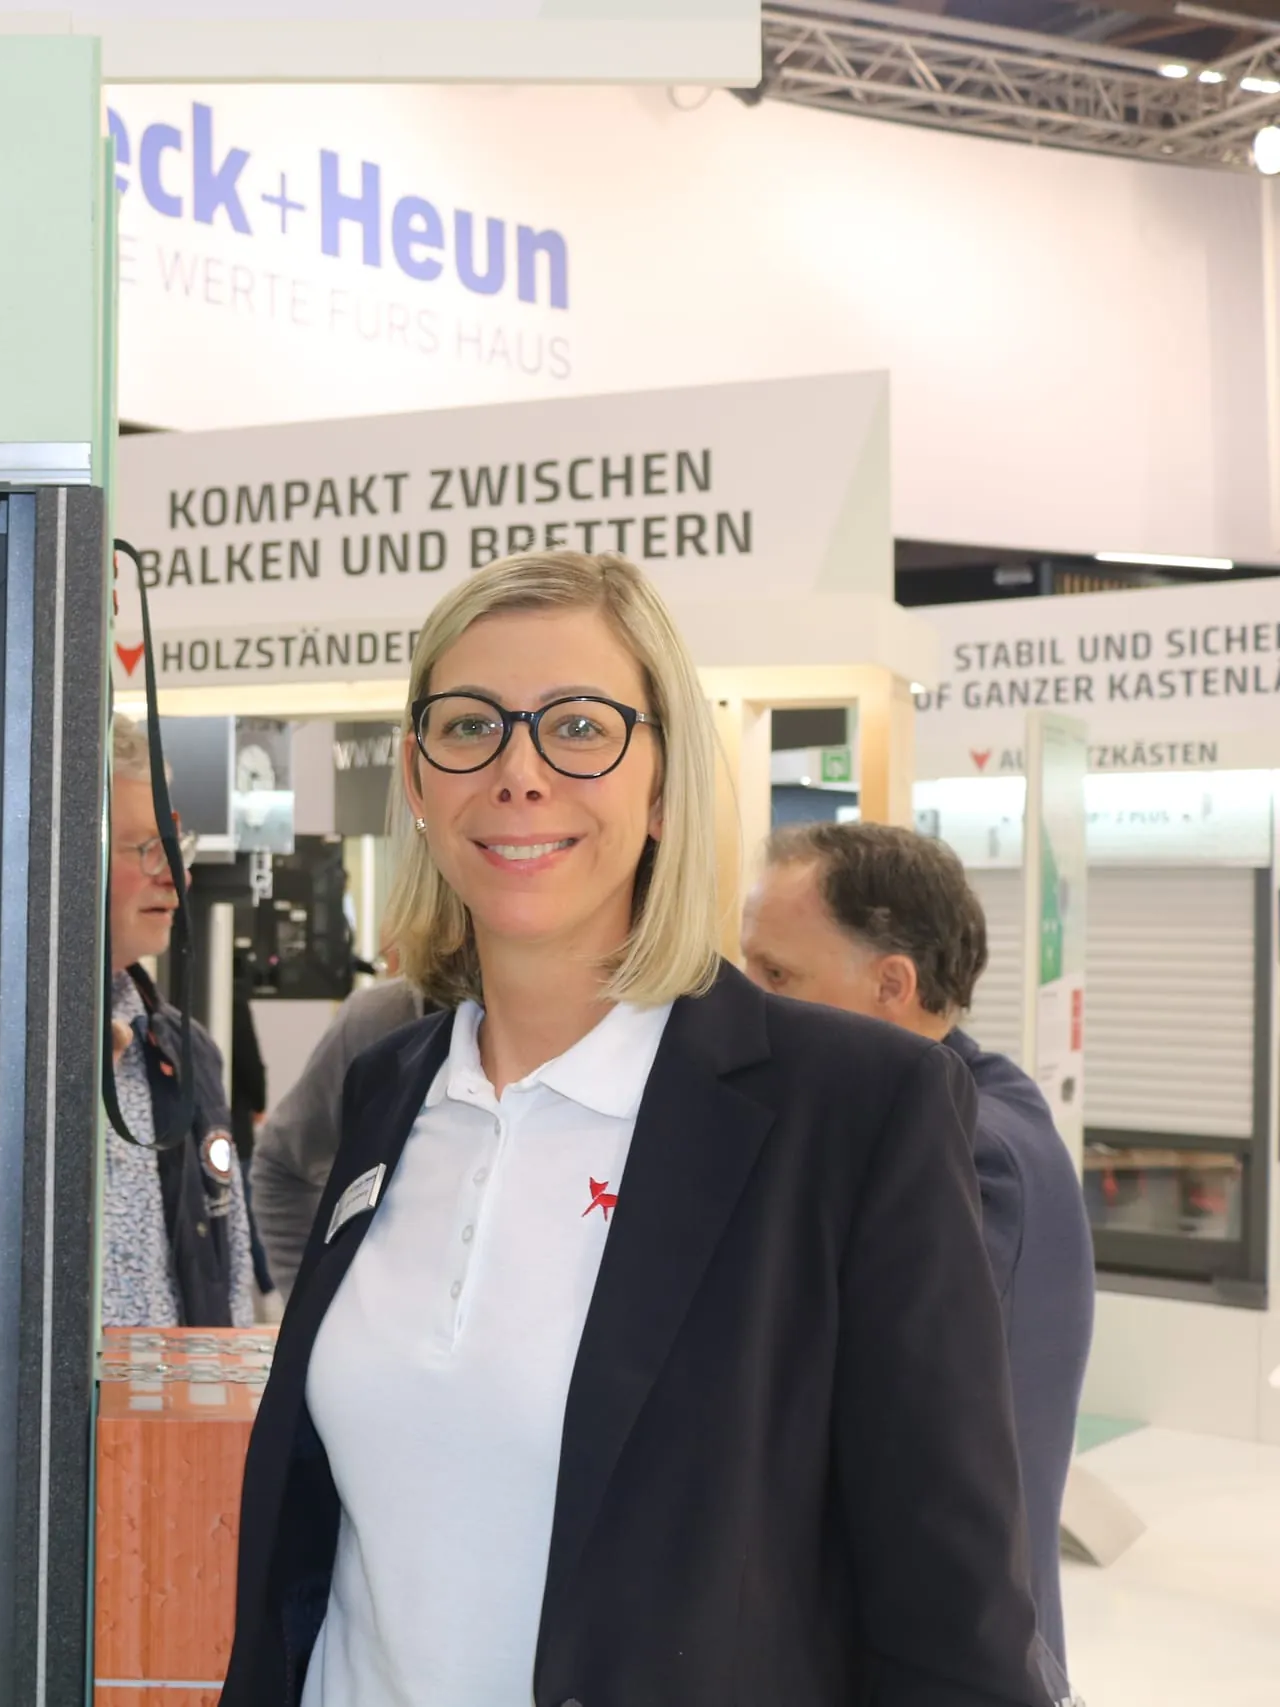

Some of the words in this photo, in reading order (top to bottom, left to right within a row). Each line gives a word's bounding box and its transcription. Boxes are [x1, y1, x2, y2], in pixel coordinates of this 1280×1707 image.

[155, 243, 313, 328] WERTE
[457, 318, 572, 381] HAUS
[168, 471, 410, 529] KOMPAKT
[428, 447, 713, 511] ZWISCHEN
[138, 538, 320, 590] BALKEN
[341, 529, 447, 577] UND
[954, 637, 1064, 673] STABIL
[1078, 631, 1152, 664] UND
[962, 674, 1095, 710] GANZER
